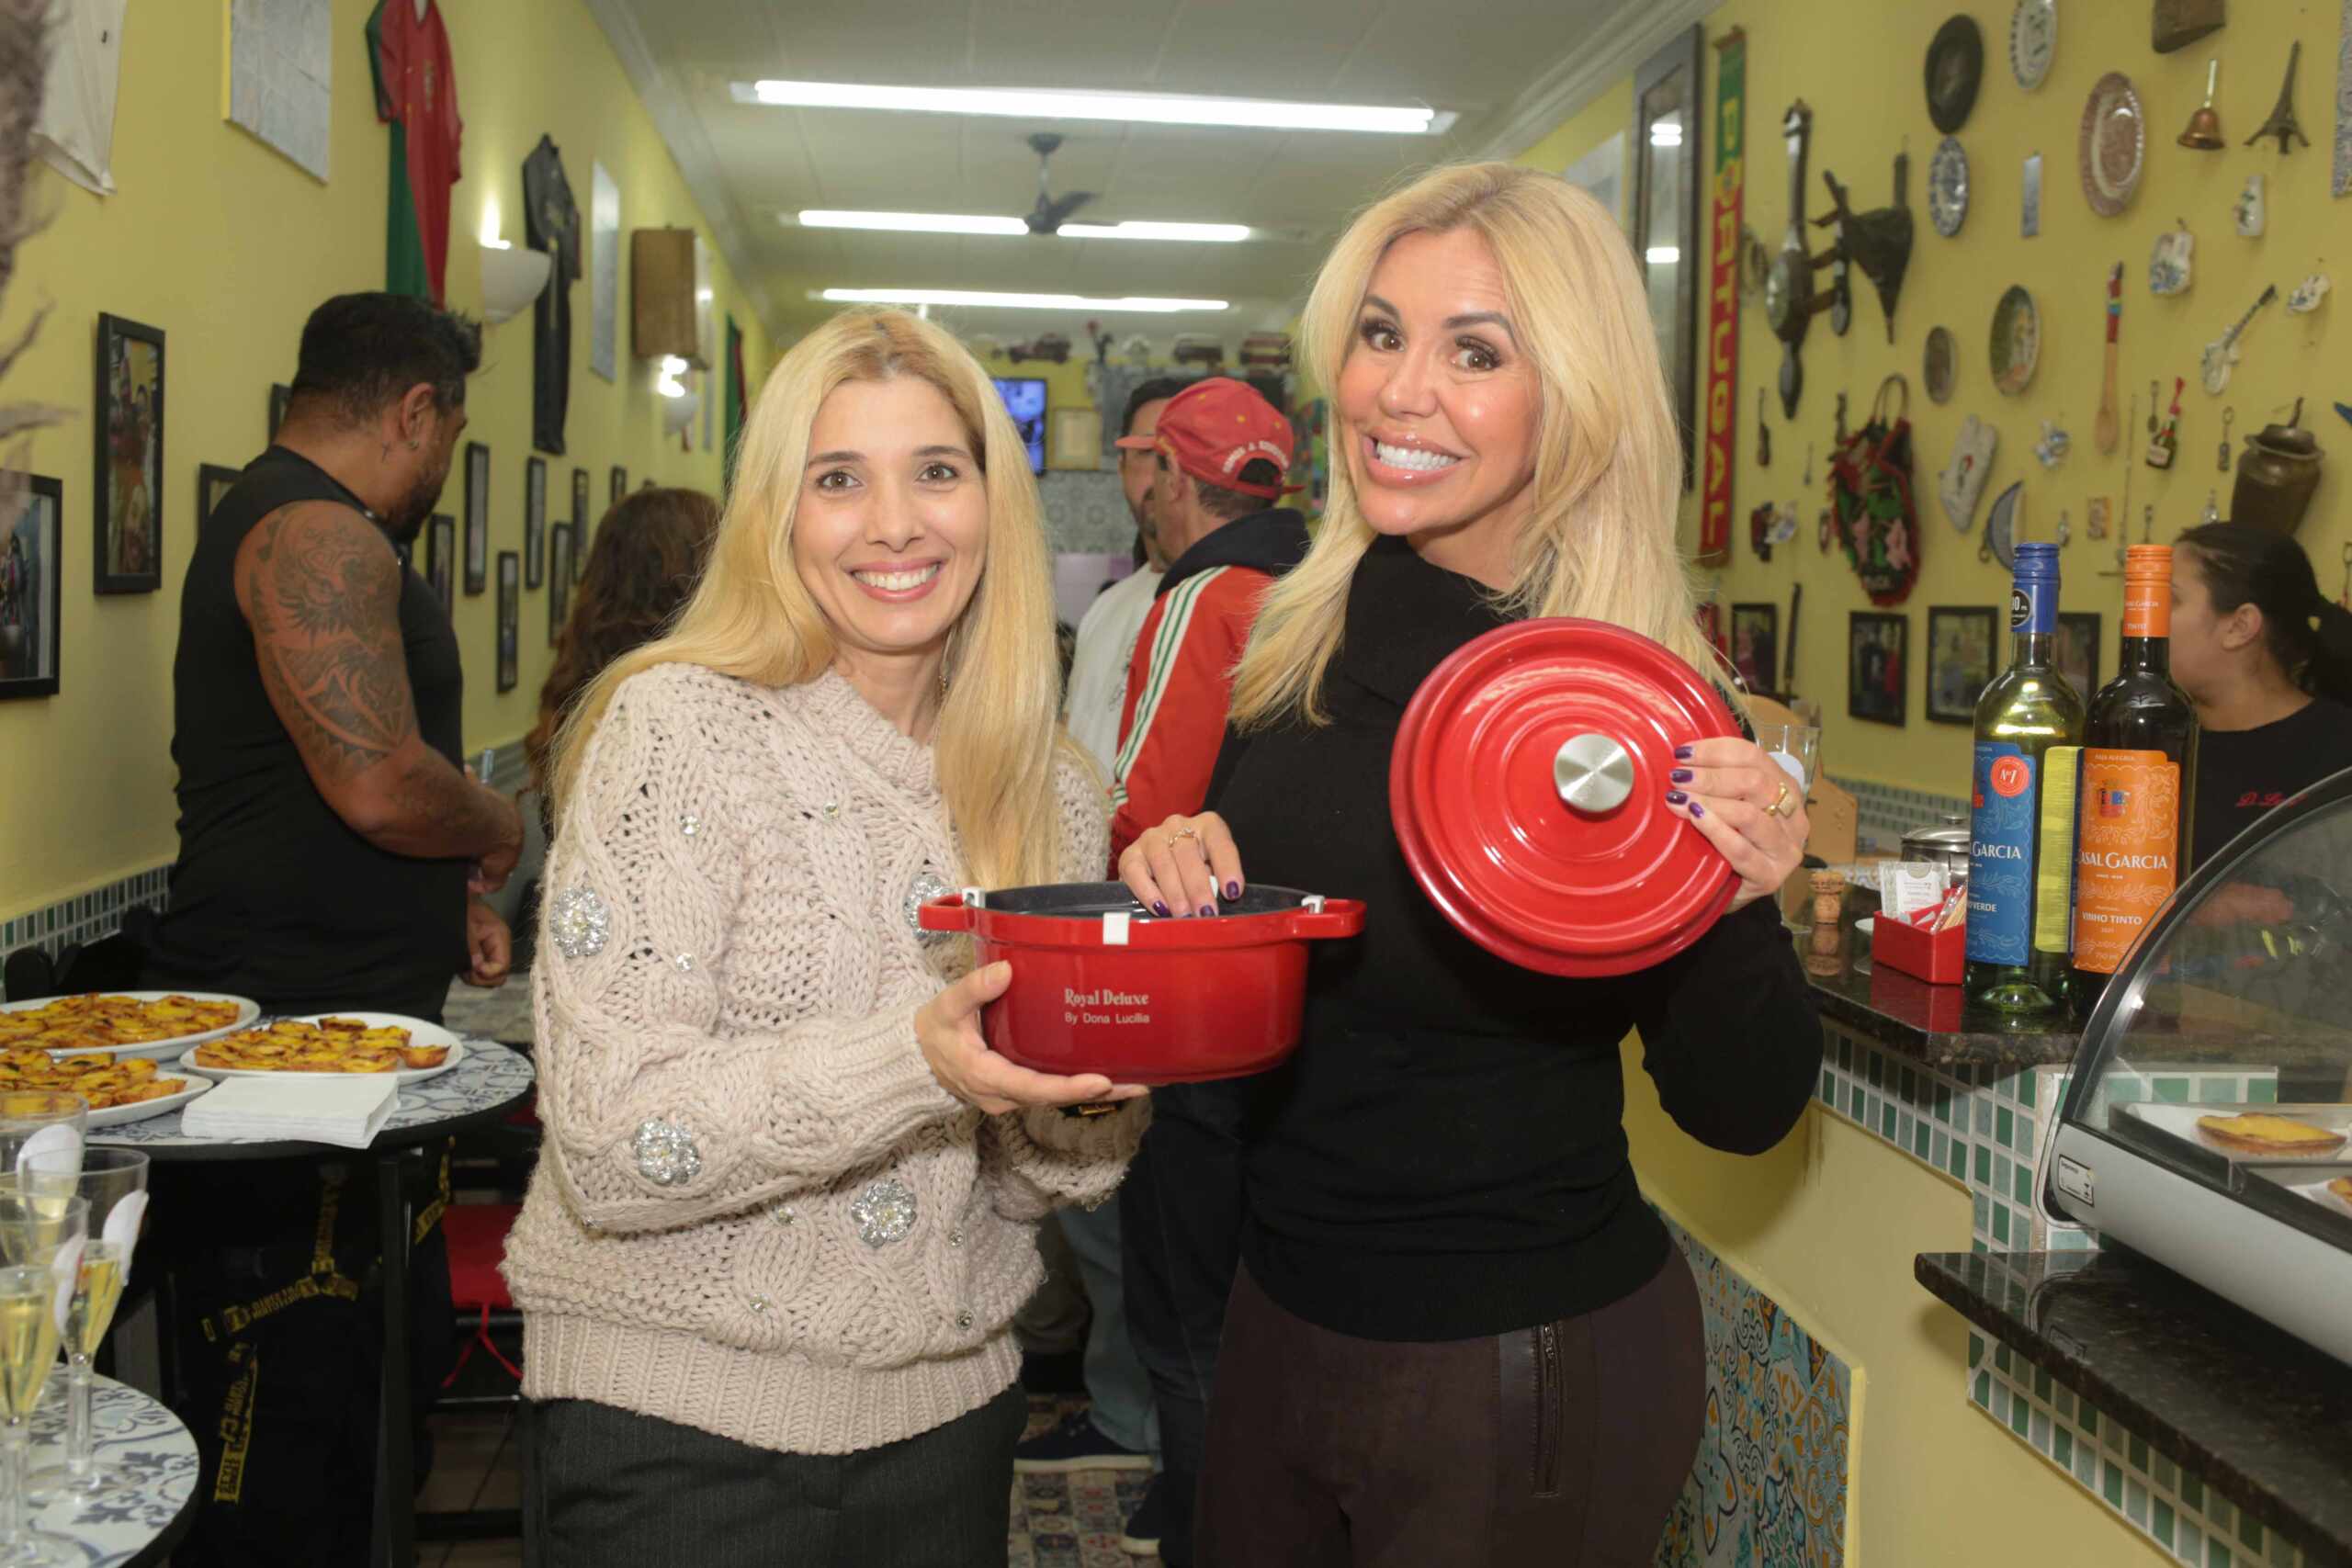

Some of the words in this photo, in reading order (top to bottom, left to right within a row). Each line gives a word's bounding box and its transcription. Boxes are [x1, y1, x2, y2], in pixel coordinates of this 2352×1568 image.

[1709, 96, 1741, 545] PORTUGAL
[1972, 840, 2021, 860] GARCIA
[2105, 852, 2169, 869] GARCIA
[2082, 911, 2108, 924] VINHO
[2110, 915, 2143, 925] TINTO
[1065, 987, 1100, 1007] Royal
[1102, 989, 1148, 1006] Deluxe
[1065, 1012, 1078, 1024] By
[1083, 1012, 1110, 1023] Dona
